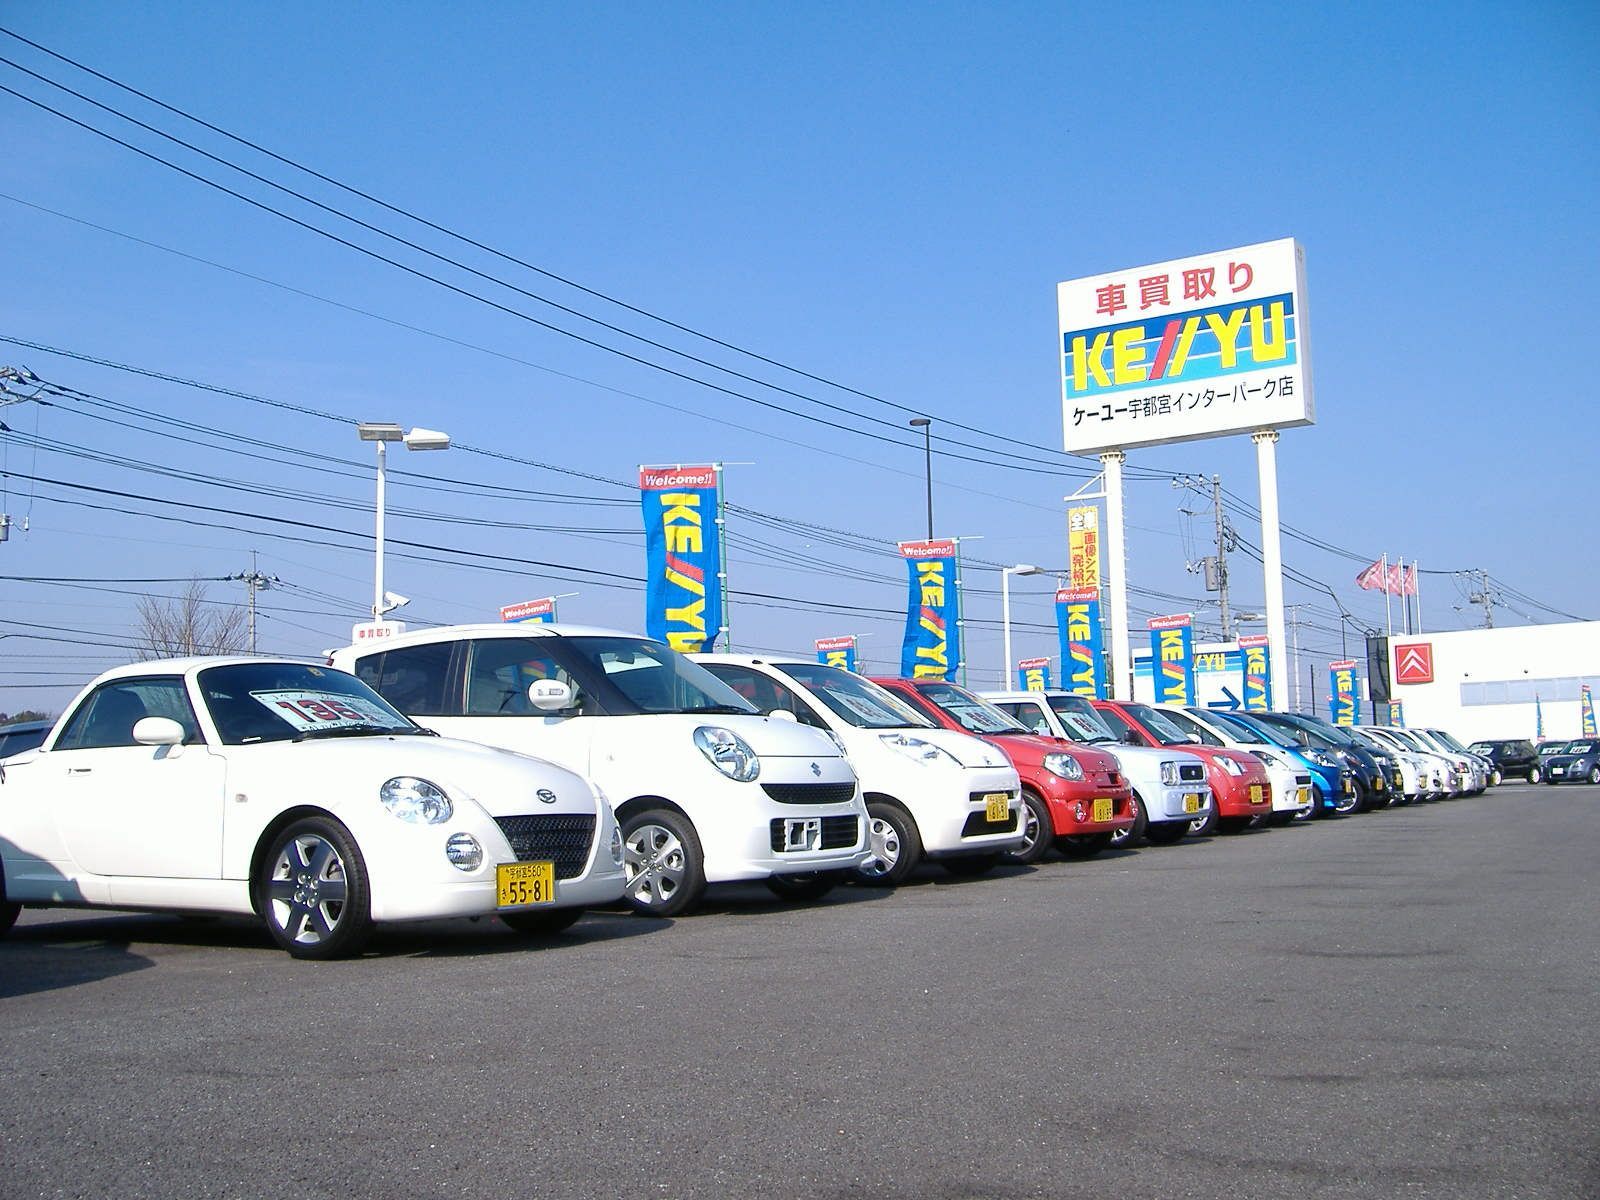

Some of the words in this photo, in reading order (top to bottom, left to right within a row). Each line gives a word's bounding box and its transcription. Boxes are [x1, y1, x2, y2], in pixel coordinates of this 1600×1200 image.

[1096, 262, 1254, 316] 車買取り
[509, 879, 549, 904] 55-81
